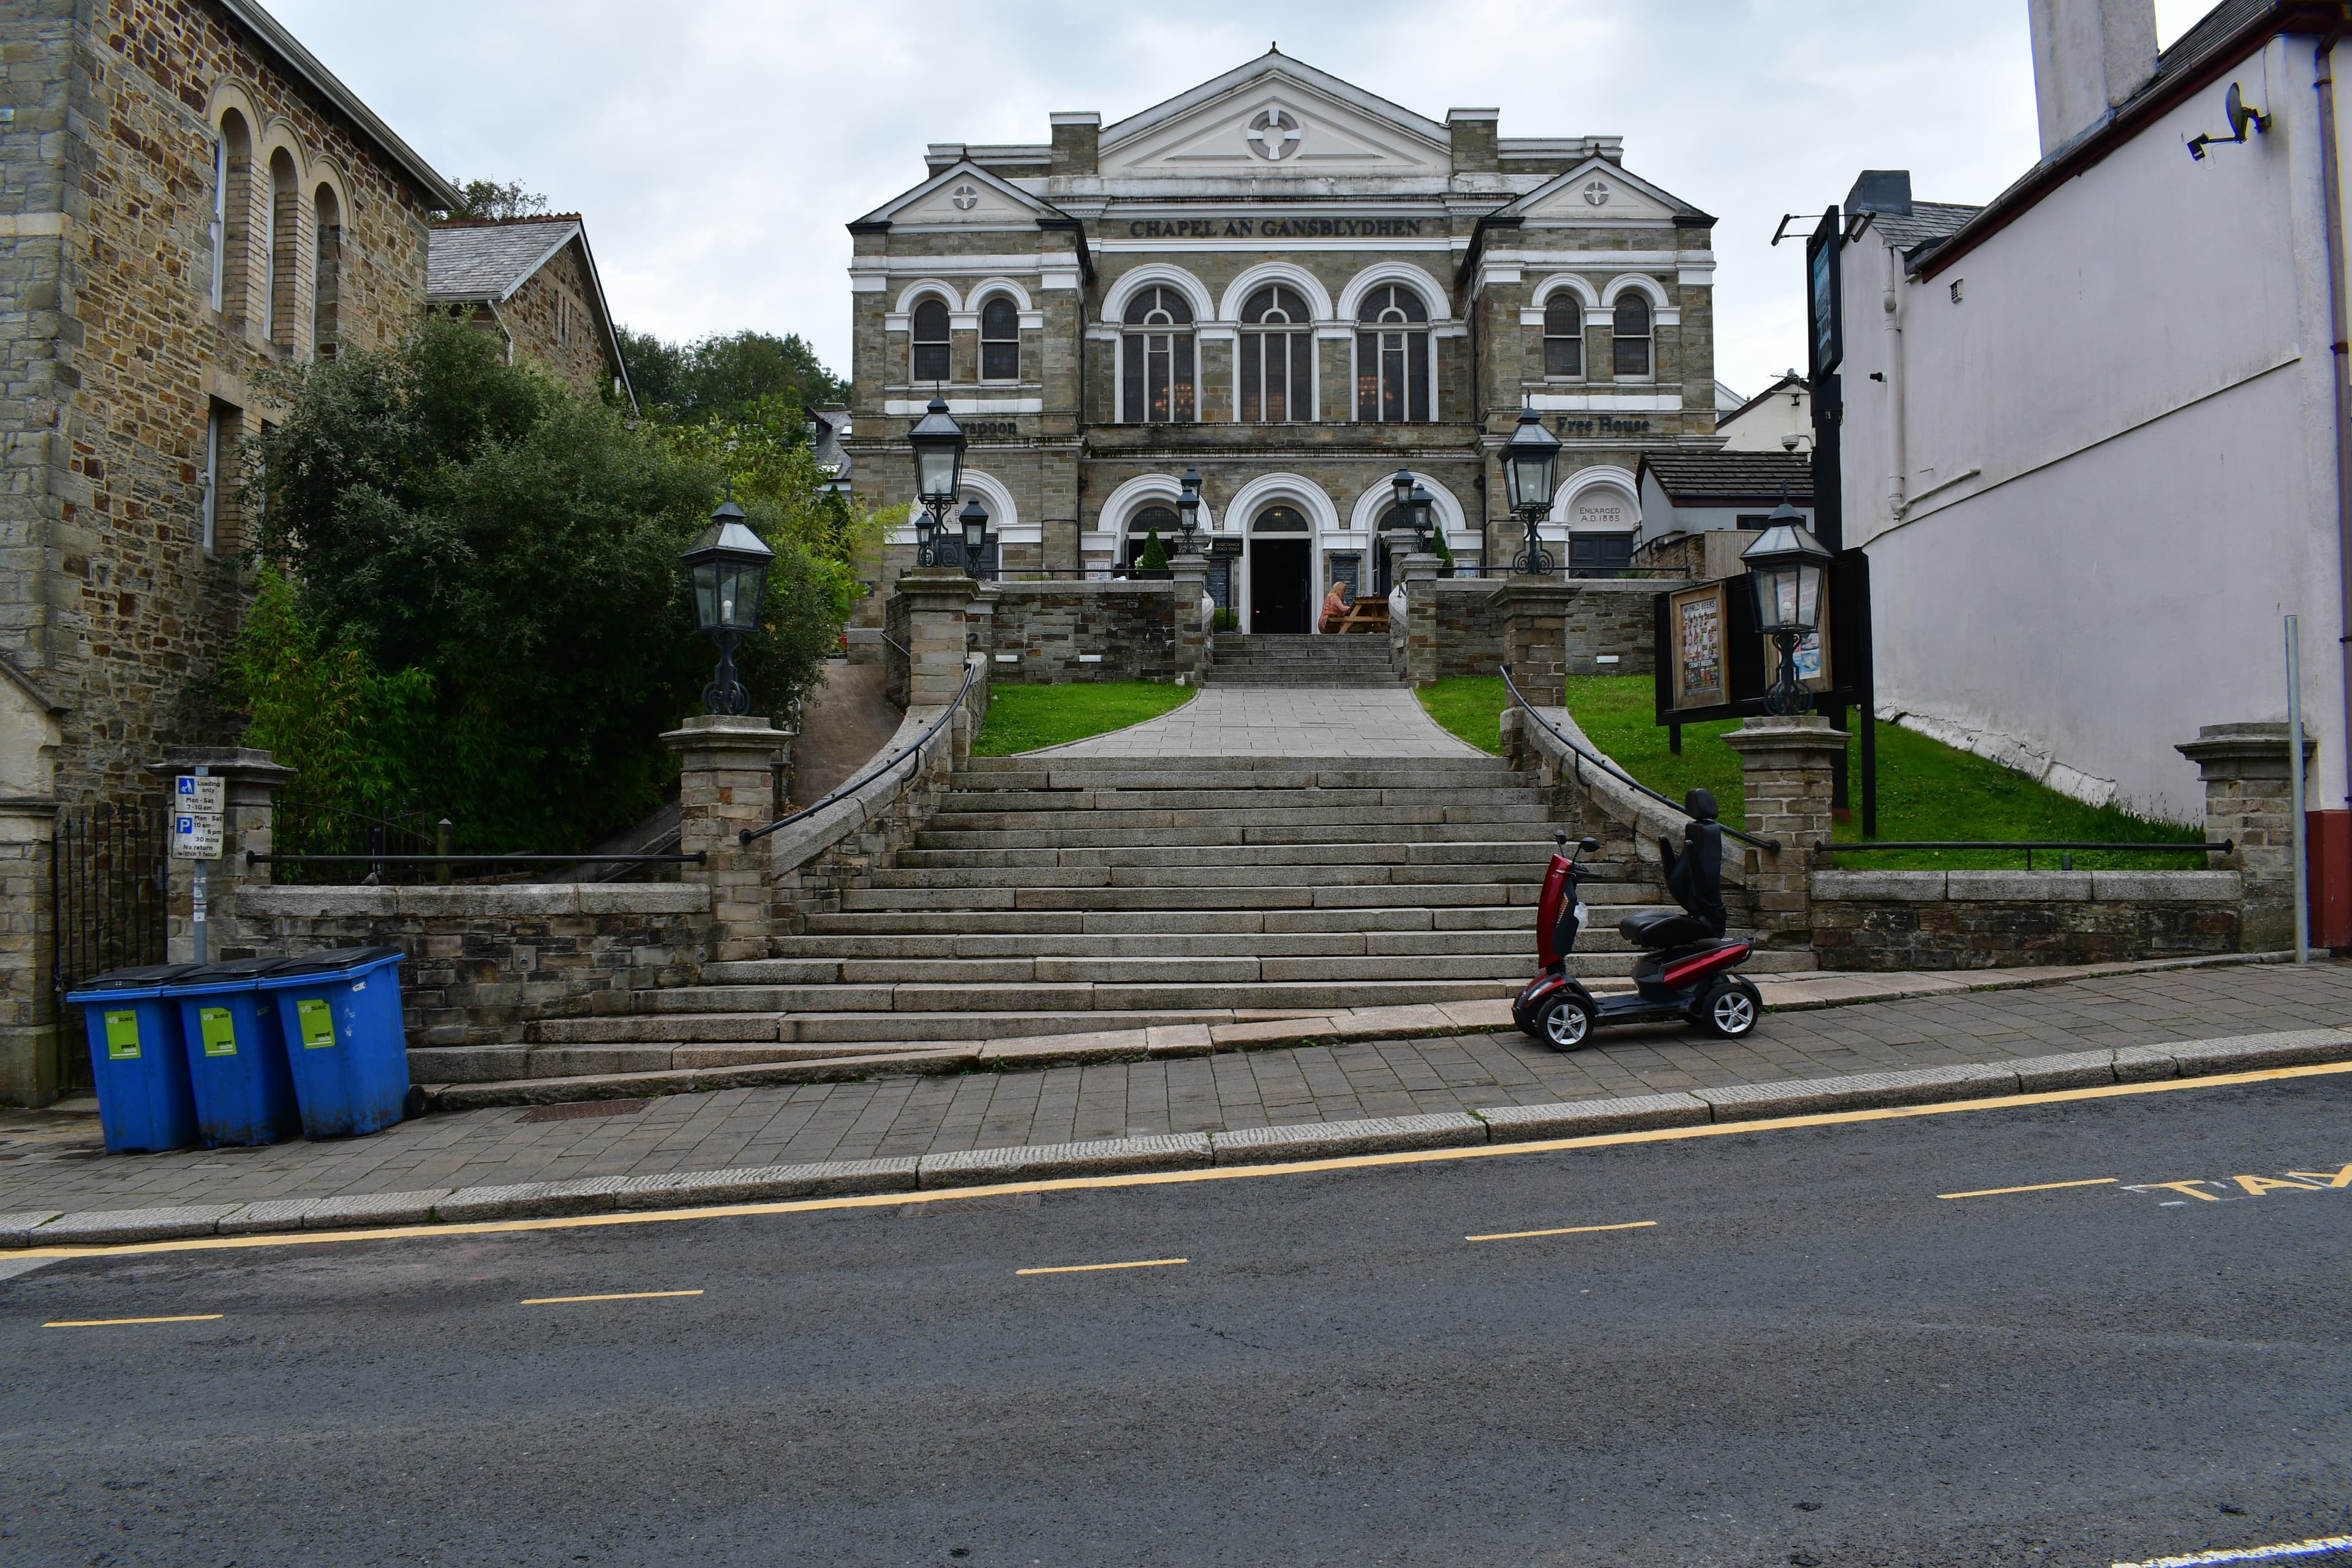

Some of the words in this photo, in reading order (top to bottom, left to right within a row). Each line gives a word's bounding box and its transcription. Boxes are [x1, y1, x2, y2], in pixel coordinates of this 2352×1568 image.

[1129, 219, 1217, 237] CHAPEL
[1224, 219, 1253, 237] AN
[1259, 219, 1422, 237] GANSBLYDHEN
[1556, 416, 1593, 431] Free
[1599, 416, 1650, 432] House
[1683, 604, 1700, 613] WORLD
[1701, 600, 1715, 609] BEERS
